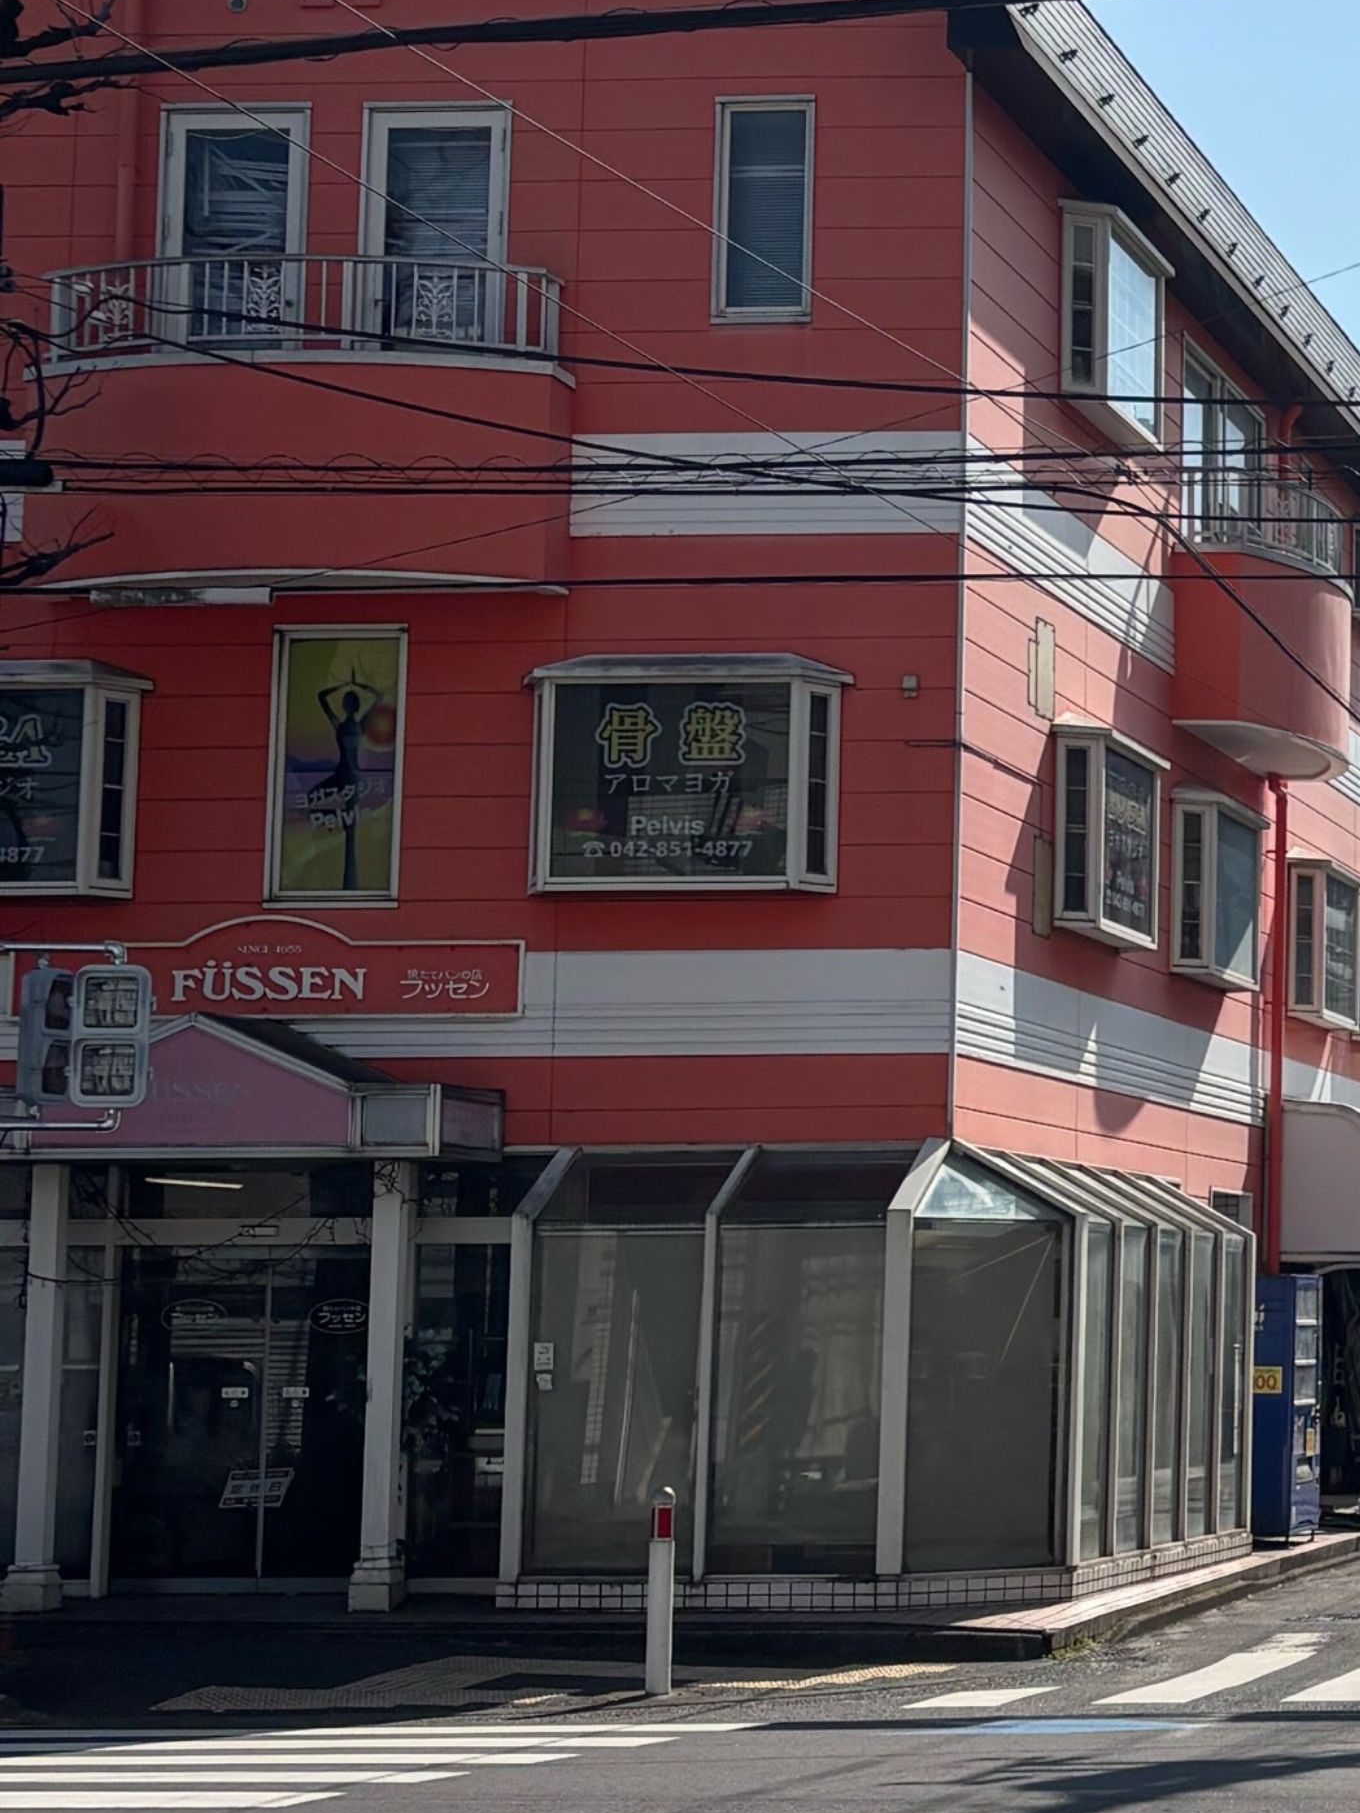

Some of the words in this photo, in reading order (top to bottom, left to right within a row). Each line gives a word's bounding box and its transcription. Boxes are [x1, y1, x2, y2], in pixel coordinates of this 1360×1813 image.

[596, 701, 746, 769] 骨盤
[603, 771, 735, 795] アロマヨガ
[630, 815, 706, 836] Pelvis
[609, 841, 753, 858] 042-851-4877
[171, 960, 367, 1001] FÜSSEN
[399, 980, 490, 999] フッセン
